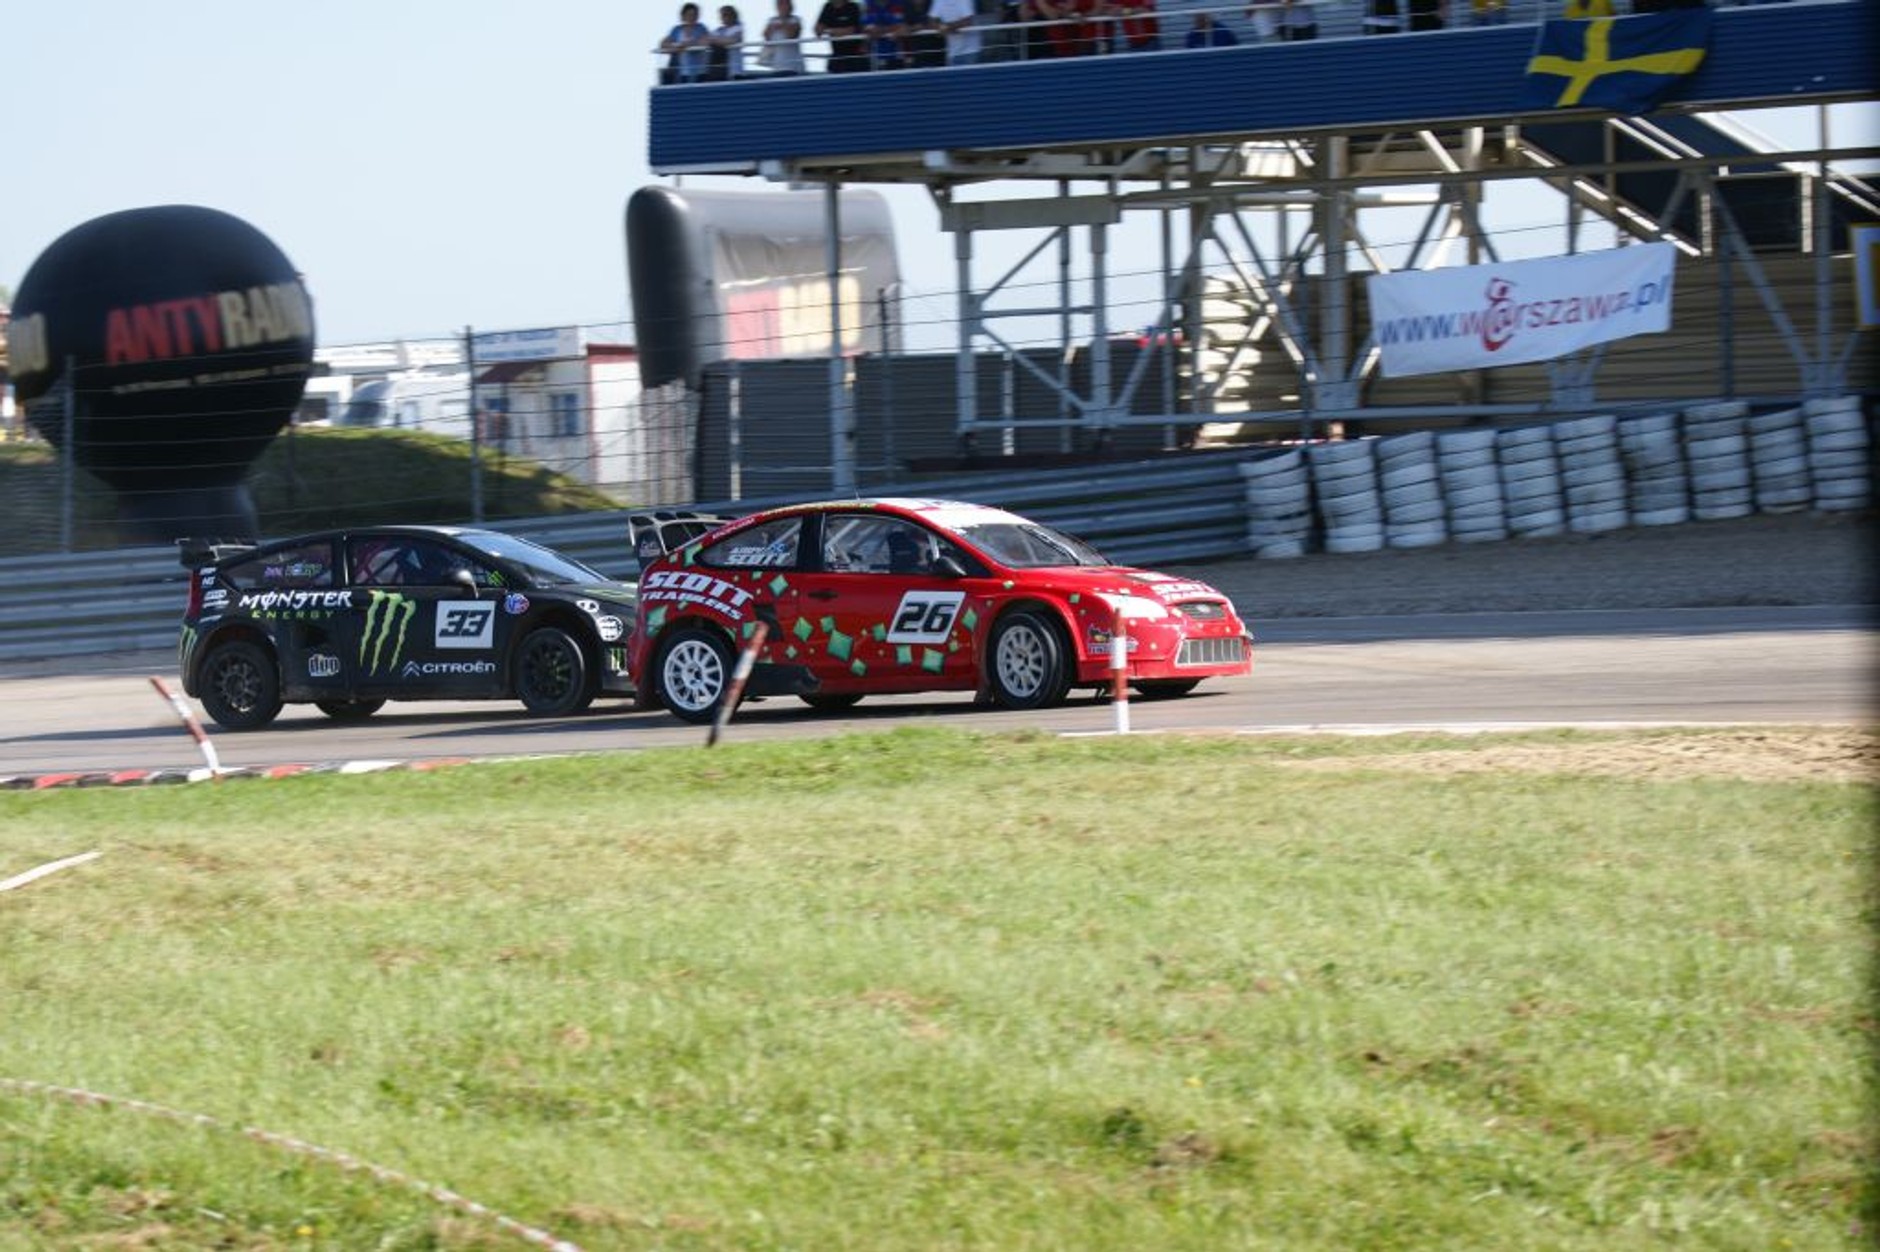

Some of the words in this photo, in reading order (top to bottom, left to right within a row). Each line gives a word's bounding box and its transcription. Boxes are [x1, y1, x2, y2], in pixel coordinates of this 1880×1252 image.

[642, 571, 754, 608] SCOTT
[251, 610, 334, 620] ENERGY
[438, 609, 492, 638] 33
[894, 600, 960, 635] 26
